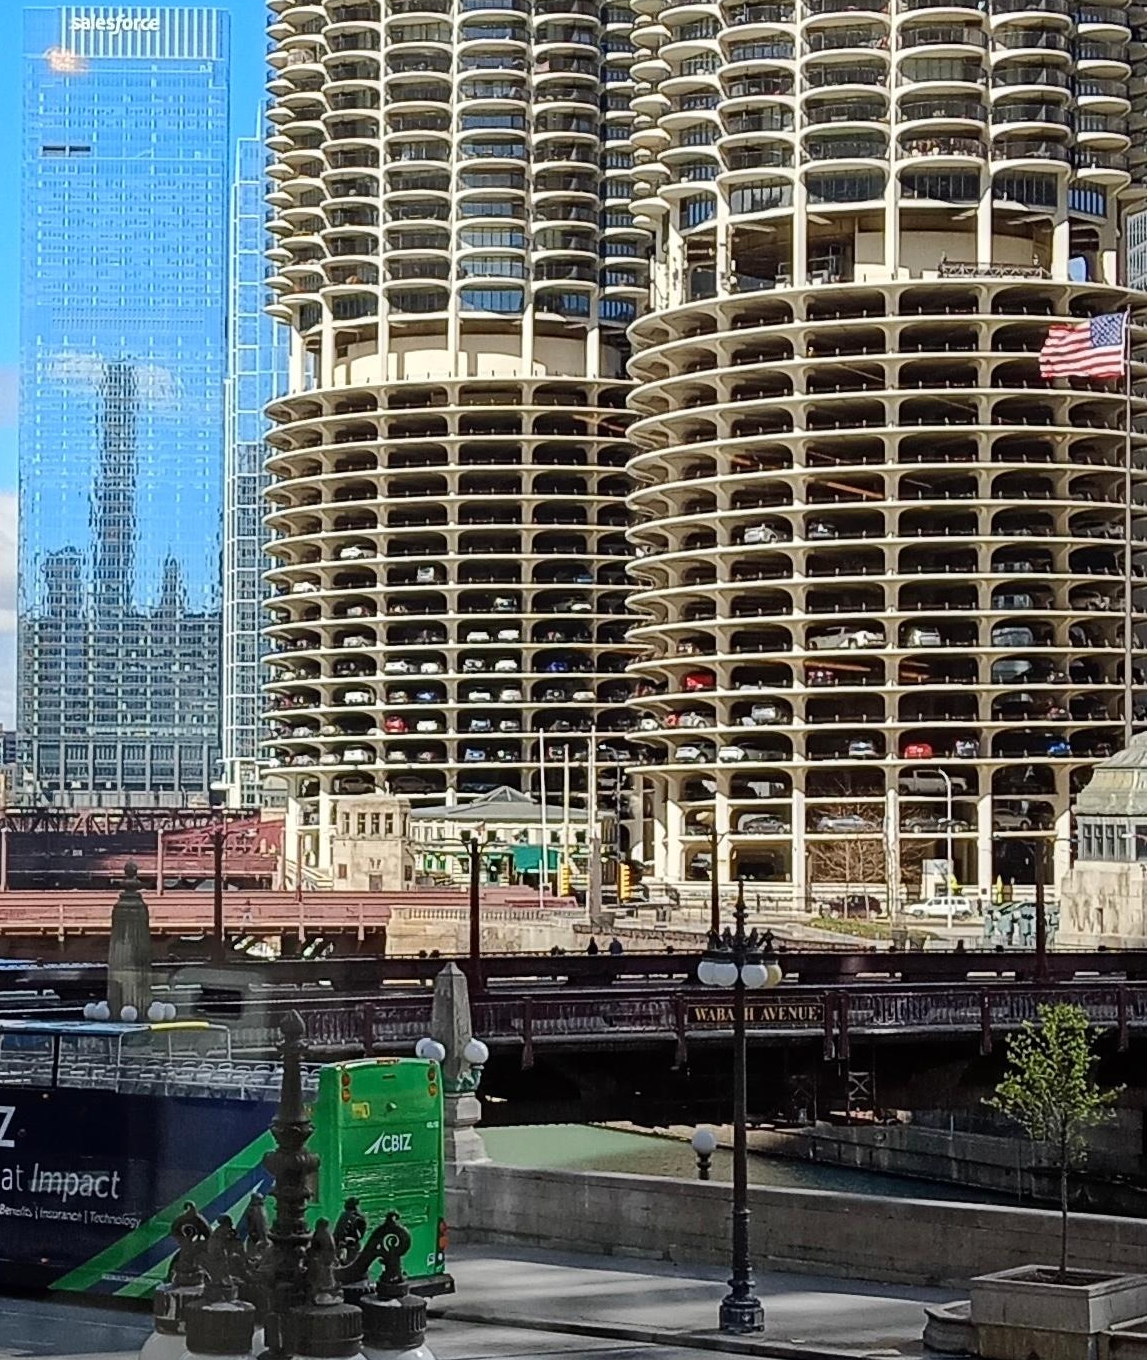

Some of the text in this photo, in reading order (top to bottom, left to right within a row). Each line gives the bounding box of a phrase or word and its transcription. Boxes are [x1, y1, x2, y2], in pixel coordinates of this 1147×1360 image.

[70, 13, 160, 35] salesforce
[695, 1005, 817, 1022] WABAH AVENUE
[382, 1133, 412, 1153] CBIZ
[30, 1162, 121, 1203] Impact
[0, 1203, 33, 1218] Benefits
[40, 1207, 83, 1222] Insurance
[90, 1211, 142, 1229] Technology
